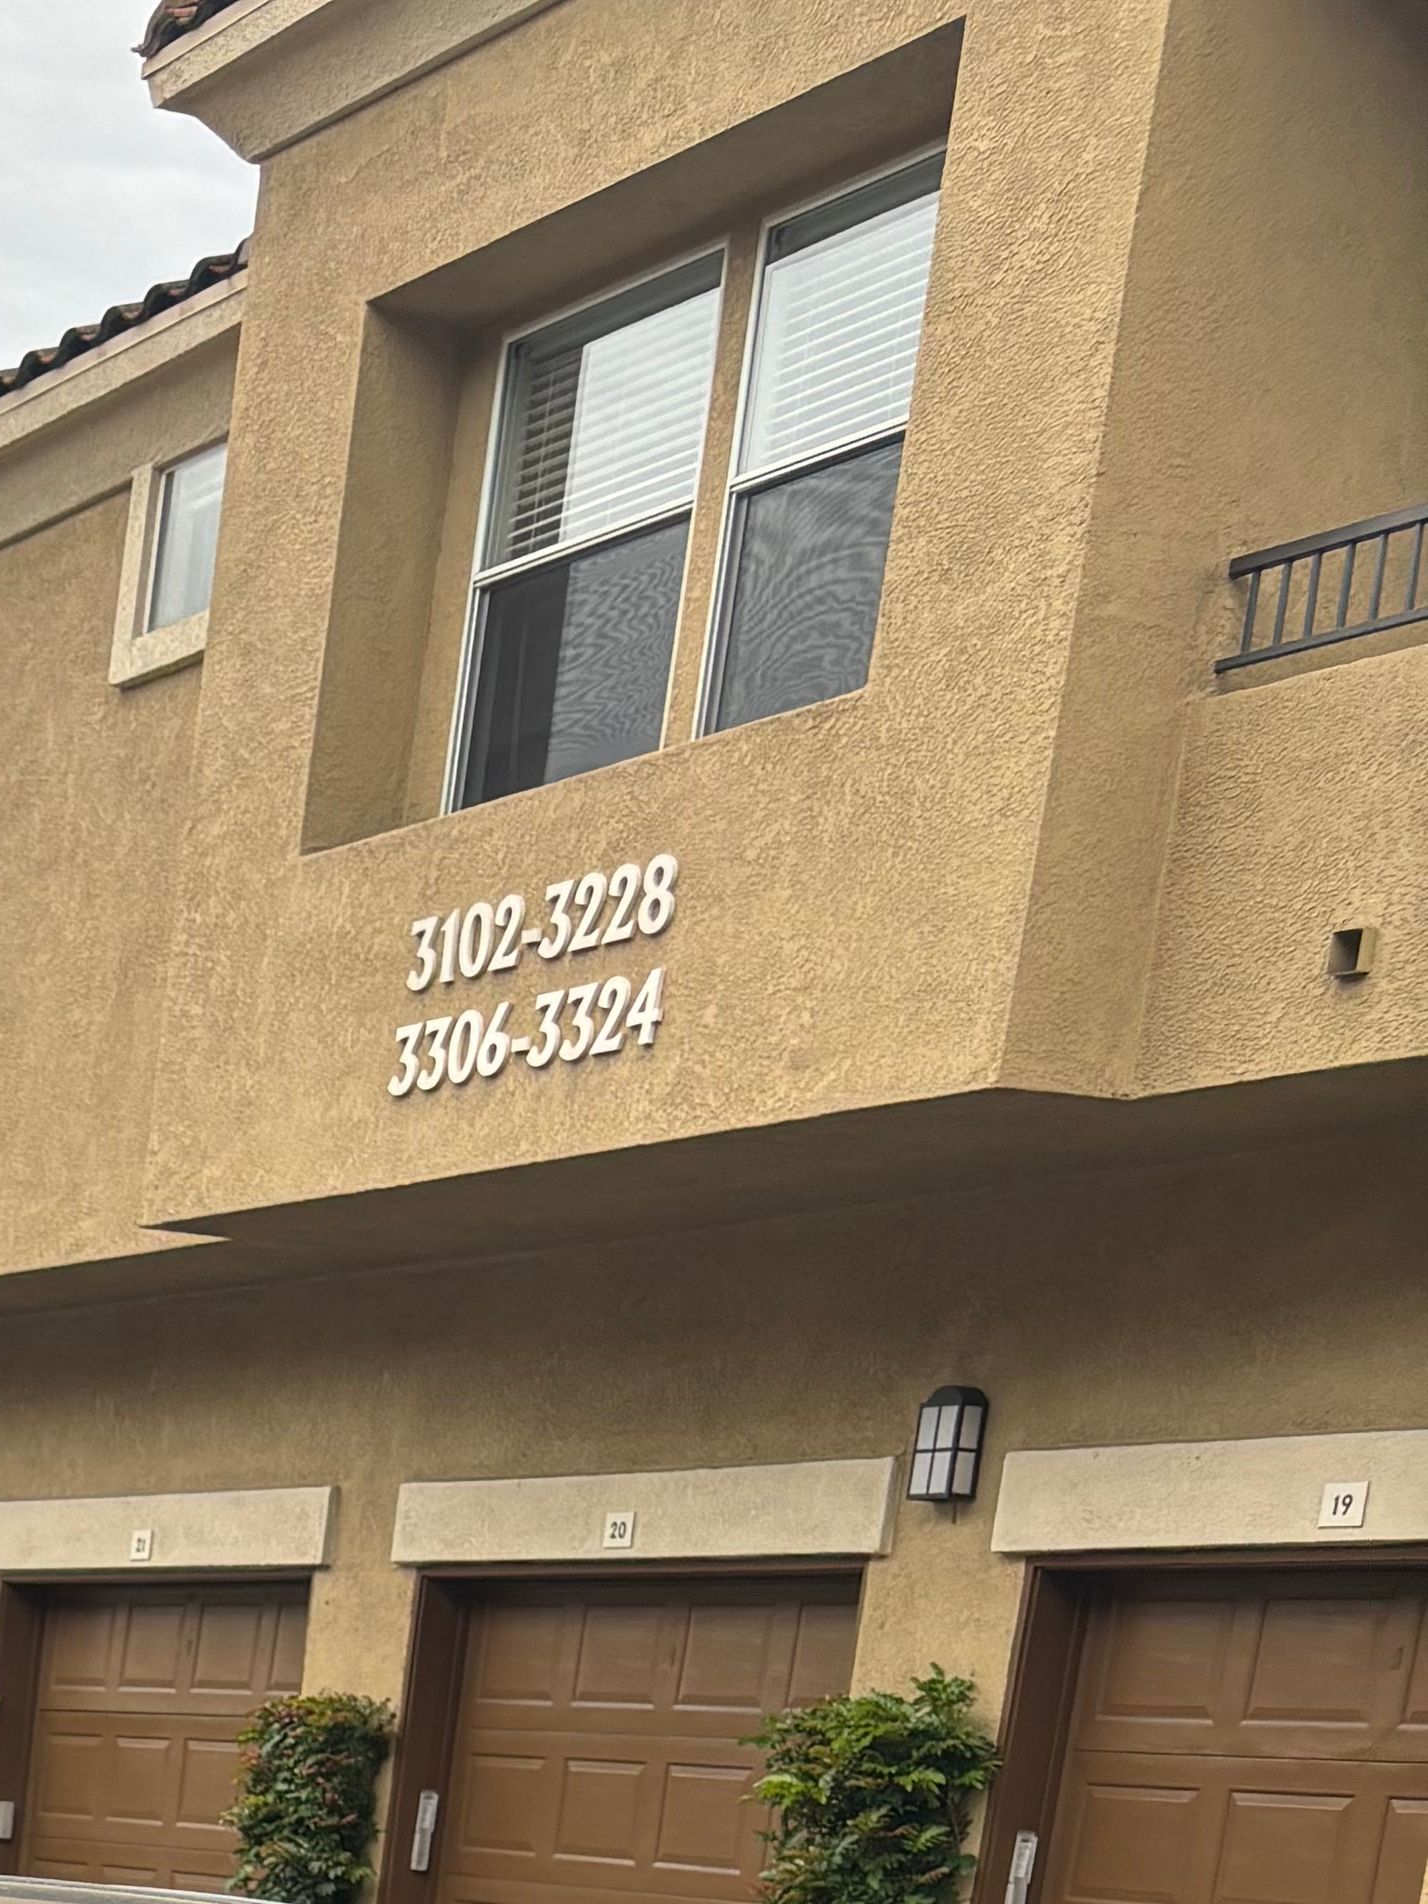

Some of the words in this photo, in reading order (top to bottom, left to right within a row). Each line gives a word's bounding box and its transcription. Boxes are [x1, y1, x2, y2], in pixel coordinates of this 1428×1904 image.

[406, 853, 679, 992] 3102-3228
[387, 968, 665, 1097] 3306-3324
[609, 1521, 627, 1539] 20
[1332, 1493, 1353, 1516] 19
